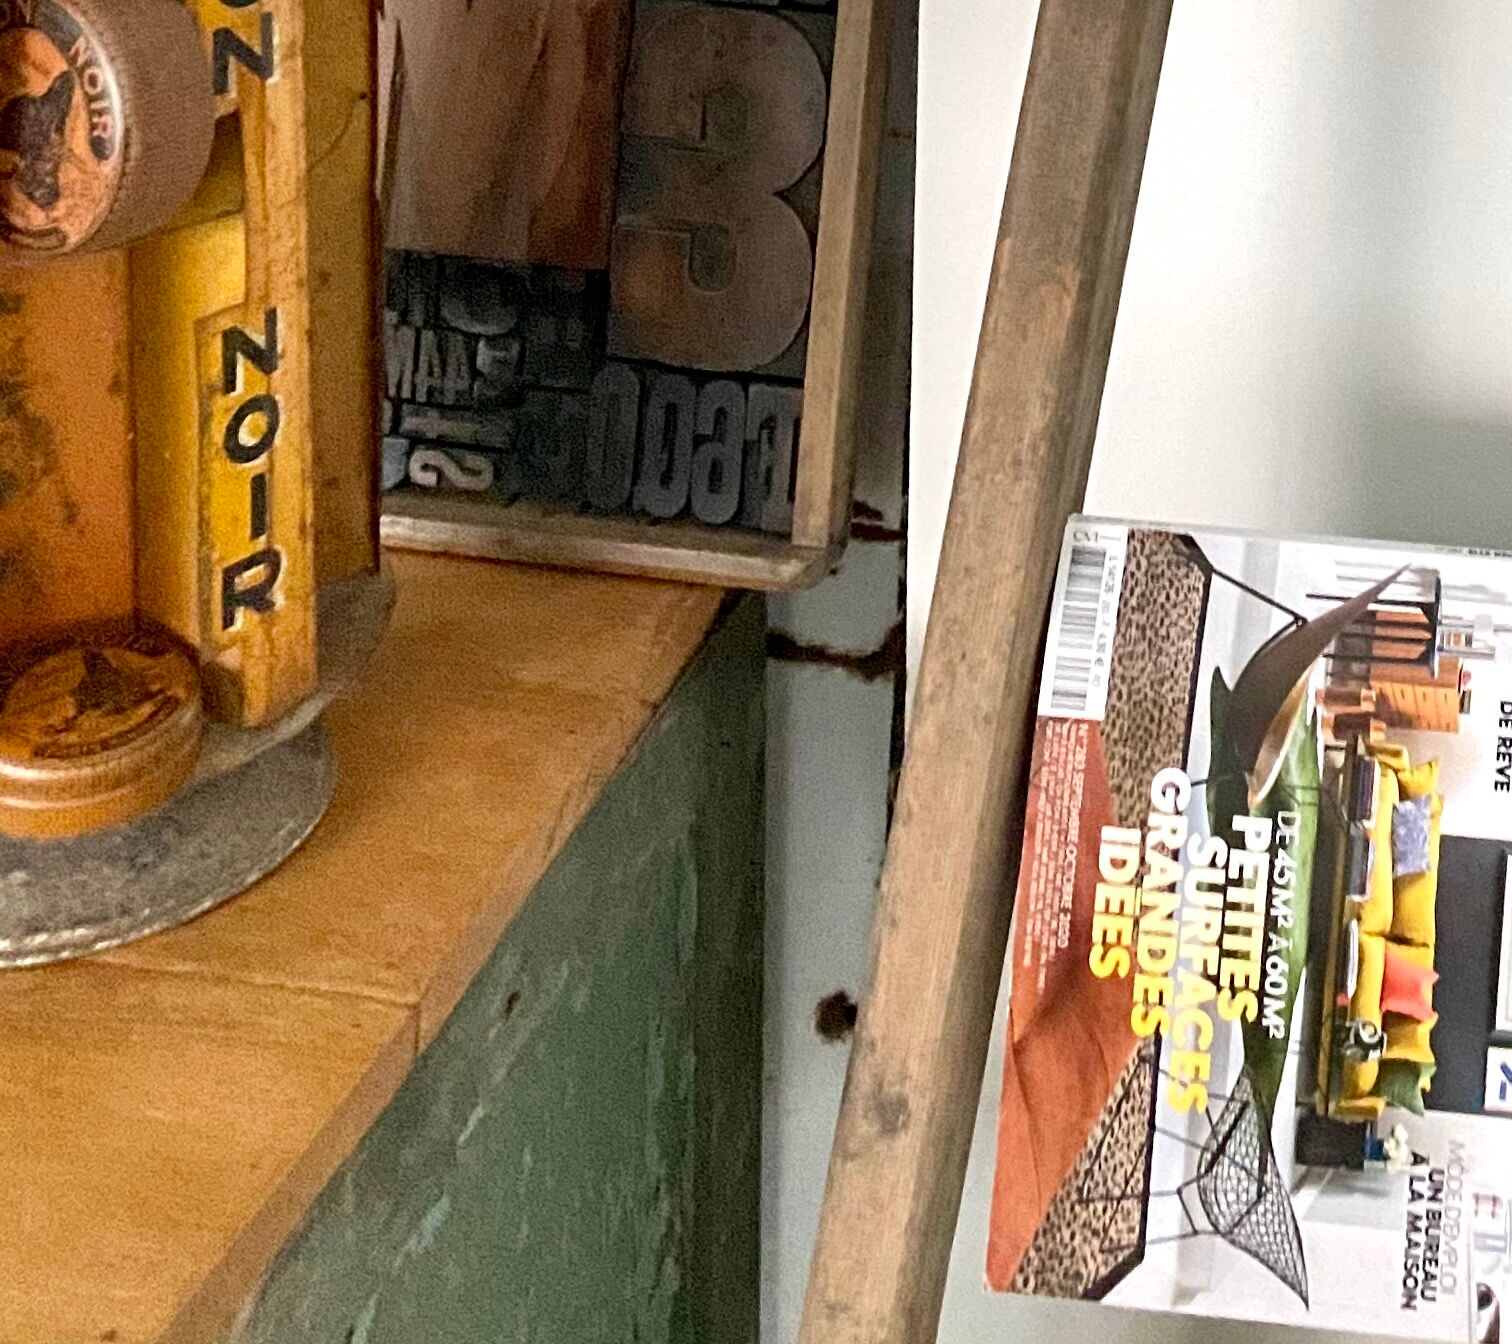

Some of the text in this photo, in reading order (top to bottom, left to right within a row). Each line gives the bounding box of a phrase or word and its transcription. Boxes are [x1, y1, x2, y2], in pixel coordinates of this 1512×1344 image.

[221, 306, 283, 632] NOIR
[1130, 766, 1192, 1038] GRANDES
[1276, 811, 1302, 847] DE
[1167, 831, 1230, 1115] SURFACES
[1216, 814, 1273, 1023] PETITES
[1402, 1212, 1424, 1311] MAISON
[1409, 1175, 1427, 1203] LA
[1421, 1167, 1445, 1303] UN BUREAU
